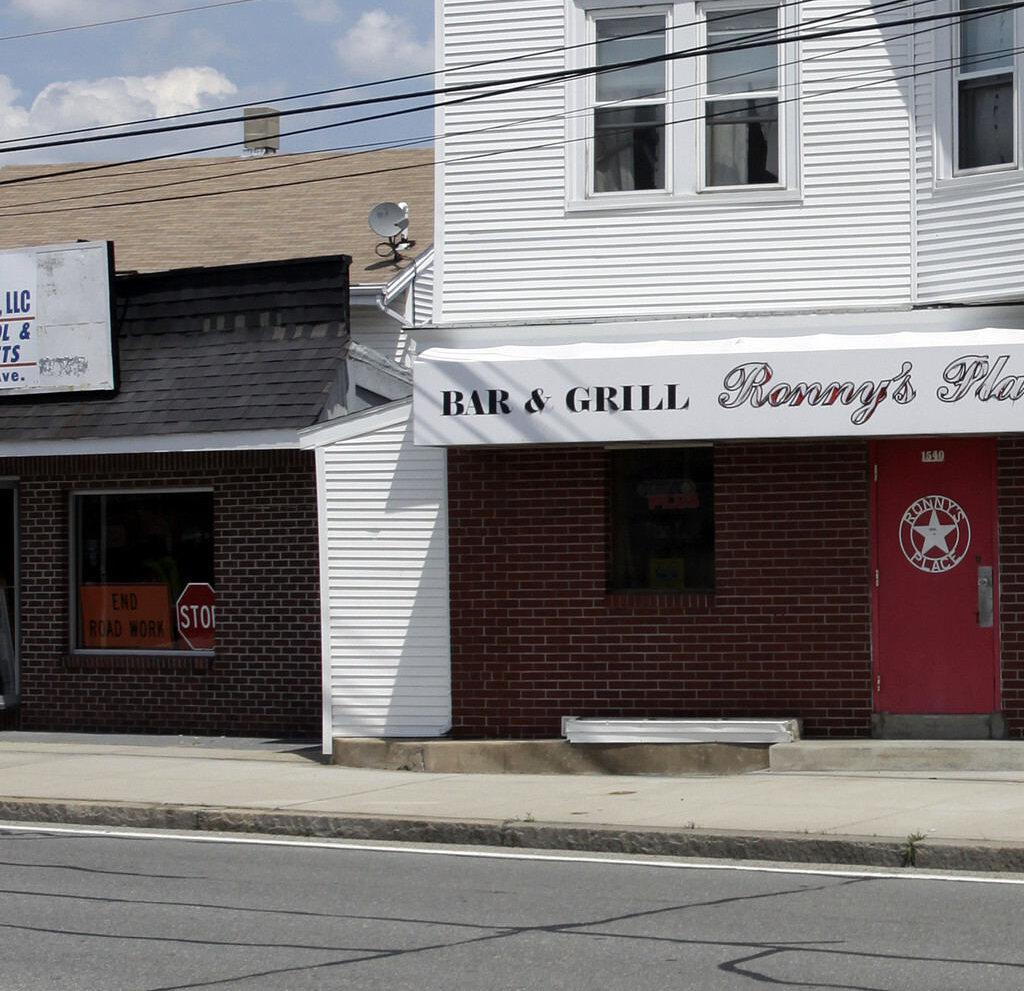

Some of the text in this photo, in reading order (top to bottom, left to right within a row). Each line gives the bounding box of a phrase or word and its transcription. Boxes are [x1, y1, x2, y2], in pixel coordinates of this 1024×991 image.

[6, 290, 31, 314] LLC
[0, 322, 31, 341] L &
[0, 345, 20, 363] TS
[0, 372, 25, 382] ve.
[440, 383, 690, 416] BAR & GRILL
[718, 361, 916, 425] Ronny's
[921, 450, 945, 462] 1540
[903, 495, 966, 525] RONNY'S
[909, 549, 962, 573] PLACE
[112, 593, 138, 611] END
[89, 620, 165, 637] ROAD WORK
